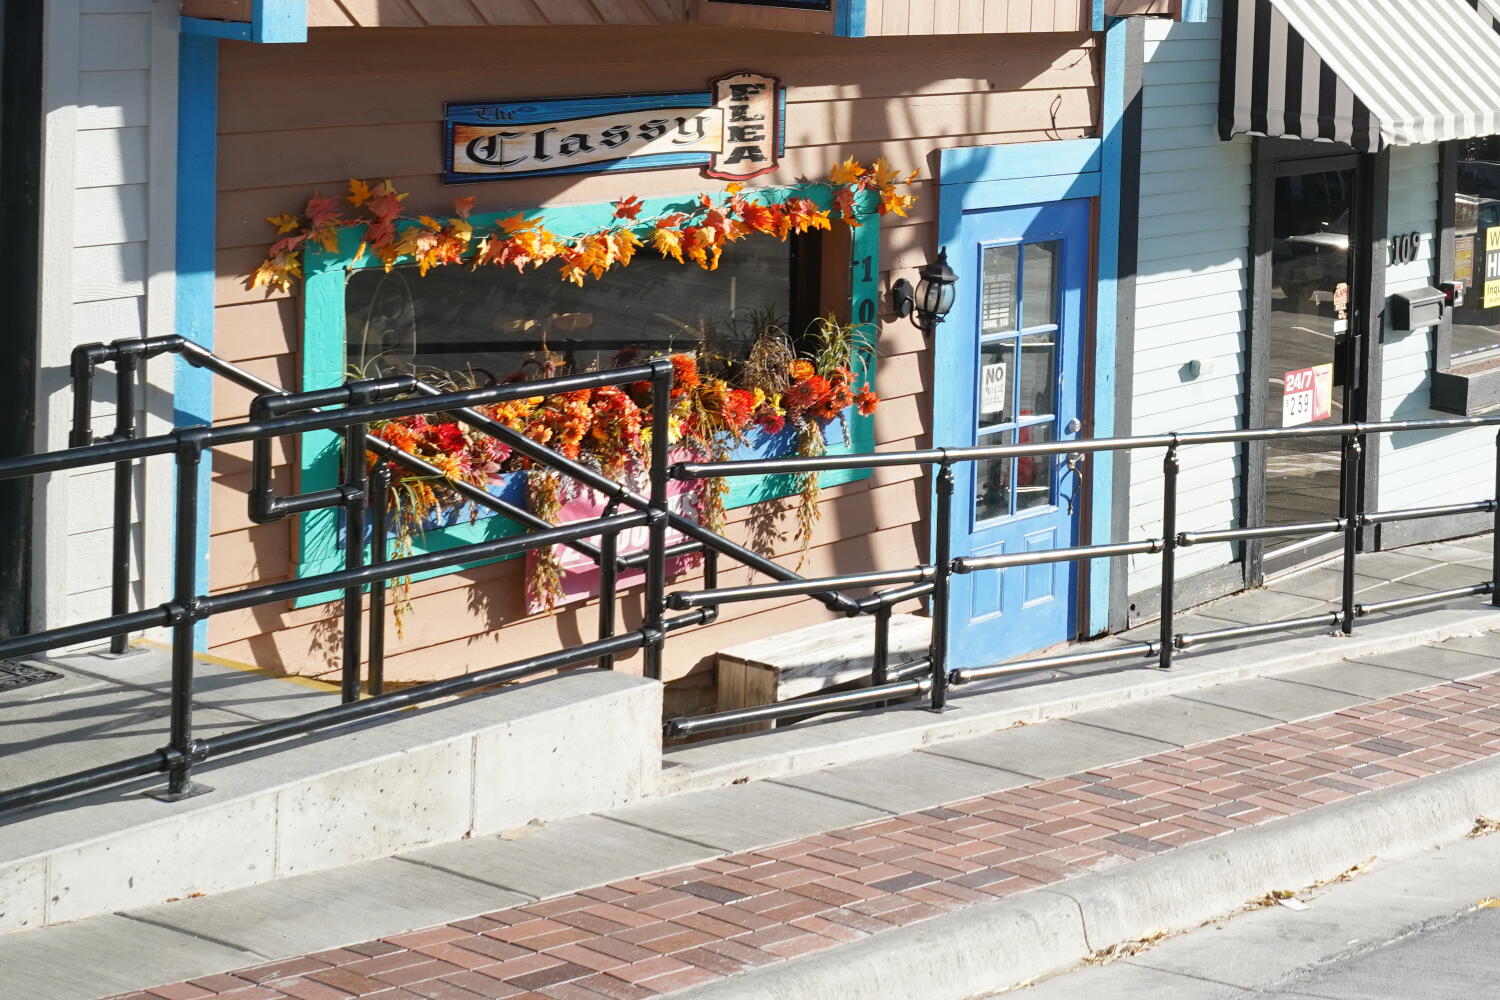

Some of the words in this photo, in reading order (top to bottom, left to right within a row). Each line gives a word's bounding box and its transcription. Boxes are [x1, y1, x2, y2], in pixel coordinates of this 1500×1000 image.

[475, 105, 517, 121] The
[723, 83, 768, 164] FLEA
[465, 114, 713, 168] Classy
[1394, 231, 1420, 266] 109
[986, 366, 1003, 386] NO
[1286, 371, 1313, 392] 24/7
